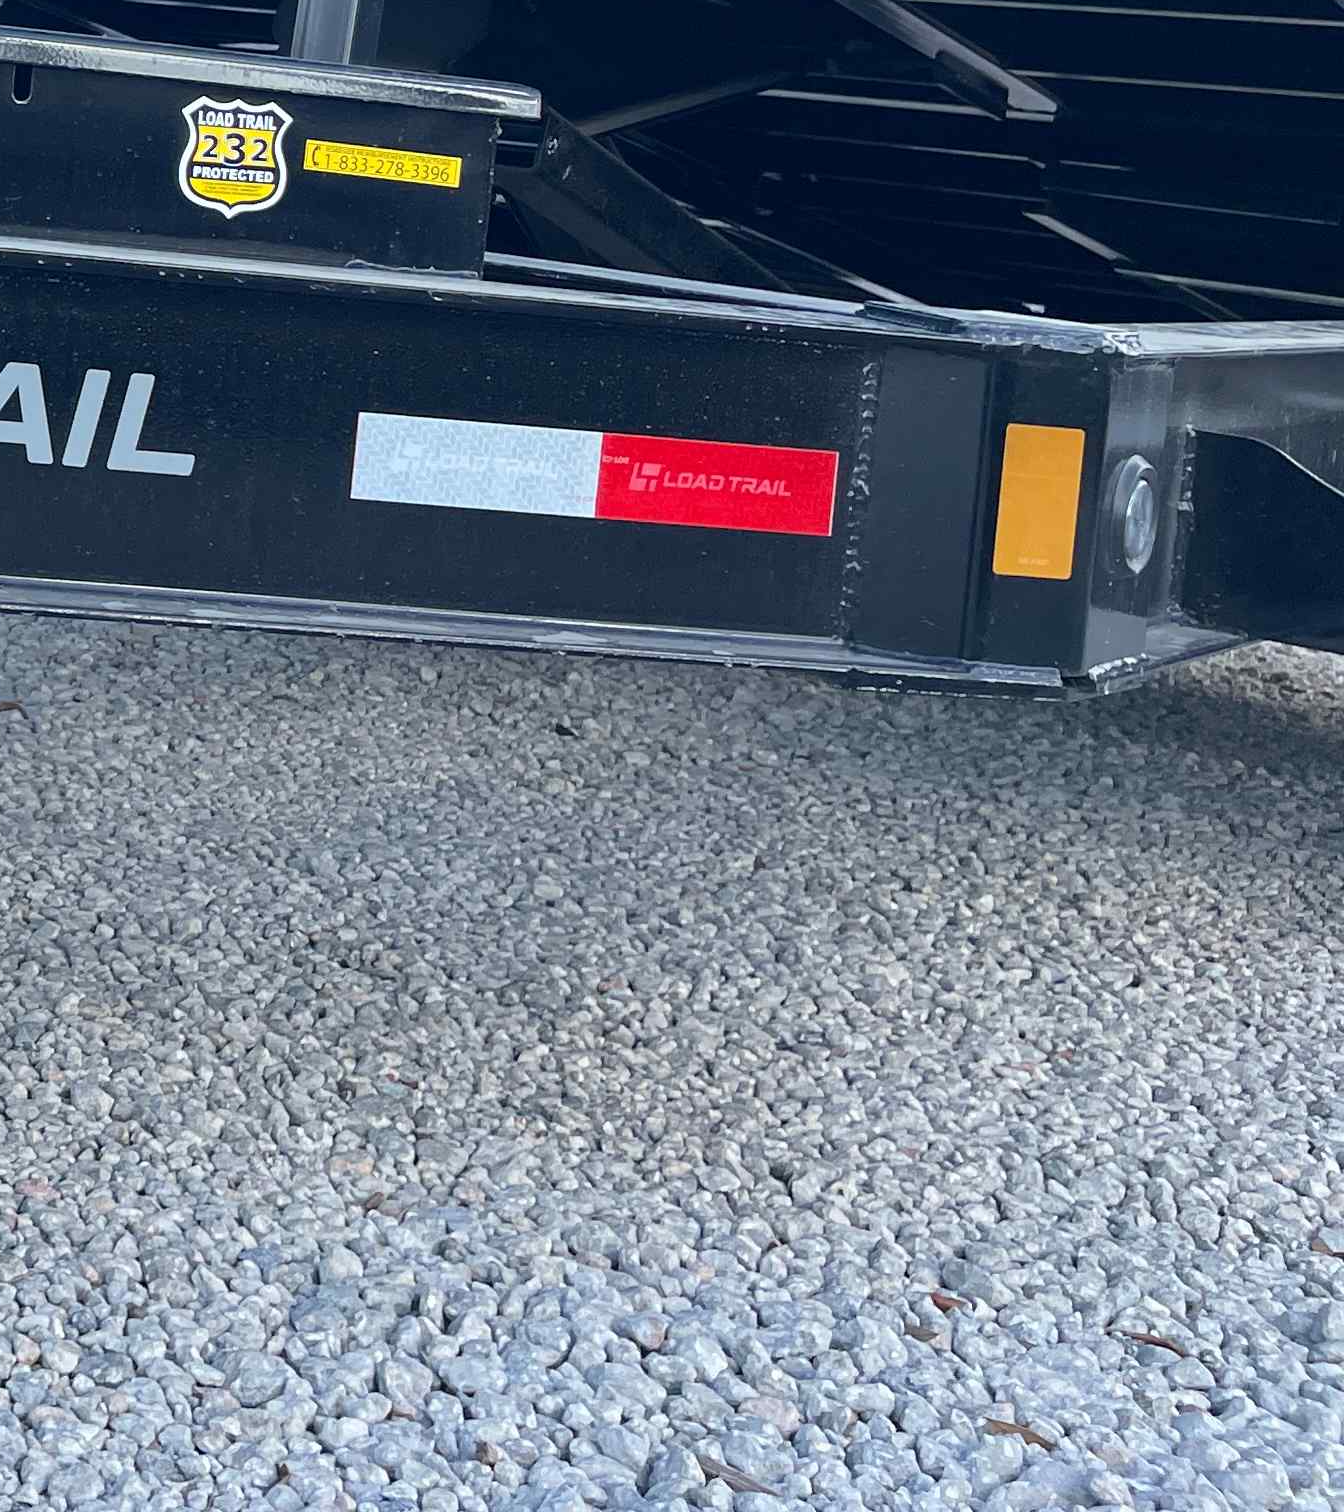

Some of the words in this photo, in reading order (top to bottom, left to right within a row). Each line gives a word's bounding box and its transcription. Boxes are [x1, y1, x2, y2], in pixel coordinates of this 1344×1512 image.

[198, 110, 235, 127] LOAD
[237, 113, 277, 131] TRAIL
[202, 132, 268, 165] 232
[192, 165, 274, 183] PROTECTED
[324, 153, 450, 182] 1-833-278-3396
[663, 470, 726, 490] LOAD
[728, 475, 792, 497] TRAIL
